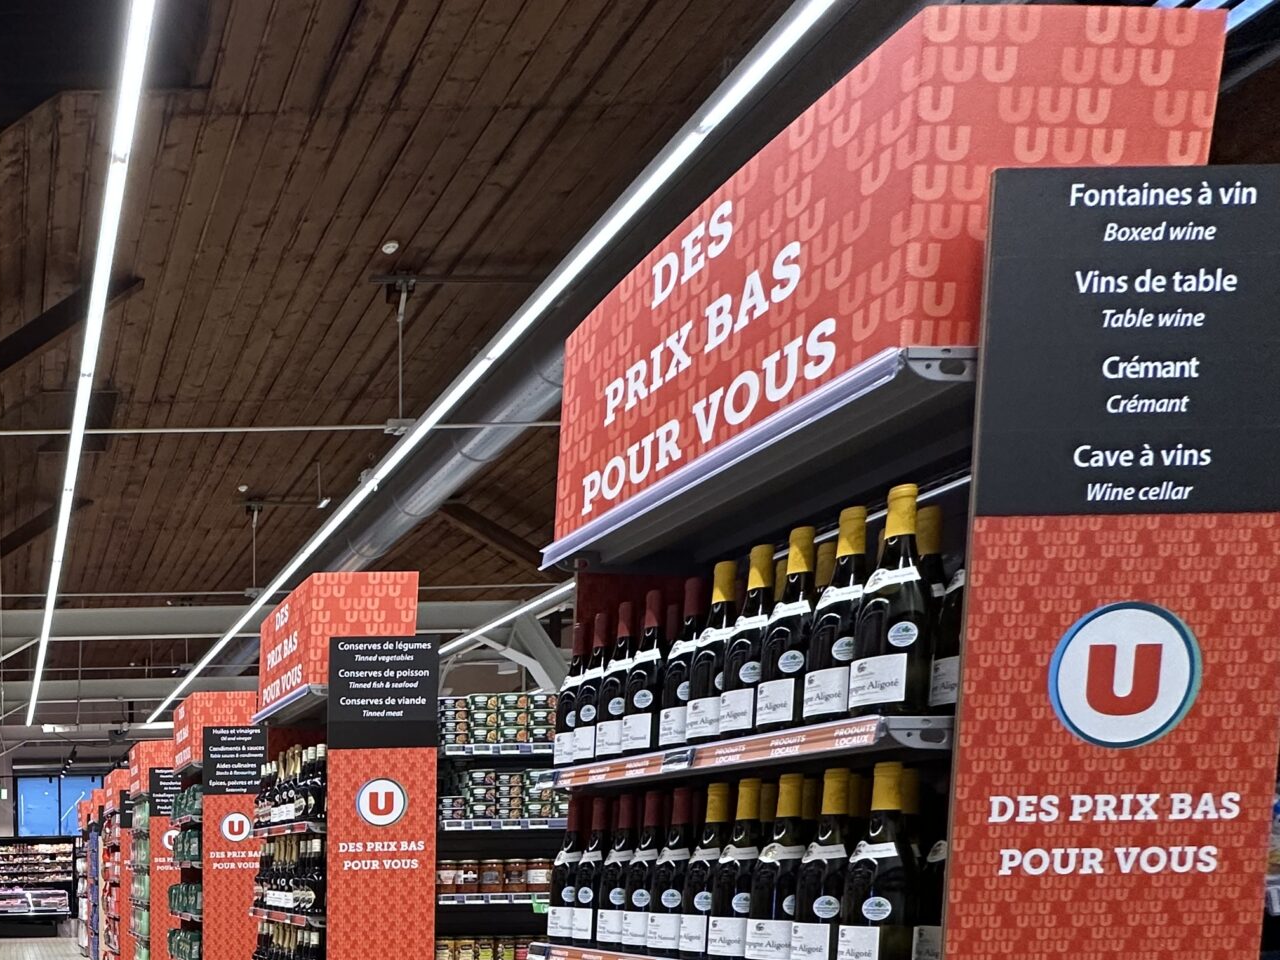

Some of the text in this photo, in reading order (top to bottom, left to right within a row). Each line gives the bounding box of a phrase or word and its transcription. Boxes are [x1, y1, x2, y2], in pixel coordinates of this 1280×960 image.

[1070, 181, 1257, 207] Fontaines à vin
[1103, 222, 1217, 242] Boxed wine
[651, 200, 733, 309] DES
[1075, 268, 1238, 293] Vins de table
[1102, 308, 1205, 328] Table wine
[604, 241, 801, 426] PRIX BAS
[1102, 355, 1200, 379] Crémant
[1106, 394, 1190, 414] Crémant
[581, 317, 836, 516] POUR VOUS
[1073, 443, 1212, 468] Cave à vins
[1086, 481, 1193, 501] Wine cellar
[275, 603, 289, 632] DES
[338, 640, 432, 651] Conserves de légumes
[338, 669, 430, 679] Conserves de poisson
[1086, 643, 1163, 715] U
[868, 678, 899, 692] Aligoté
[340, 696, 427, 705] Conserves de viande
[814, 690, 842, 704] Aligoté
[834, 724, 877, 737] PRODUITS
[834, 734, 871, 747] LOCAUX
[770, 735, 807, 747] PRODUITS
[770, 745, 800, 757] LOCAUX
[988, 792, 1241, 823] DES PRIX BAS
[339, 840, 425, 852] DES PRIX BAS
[213, 862, 235, 870] POUR
[343, 858, 419, 870] POUR VOUS
[999, 845, 1218, 875] POUR VOUS
[844, 948, 873, 960] Aligoté
